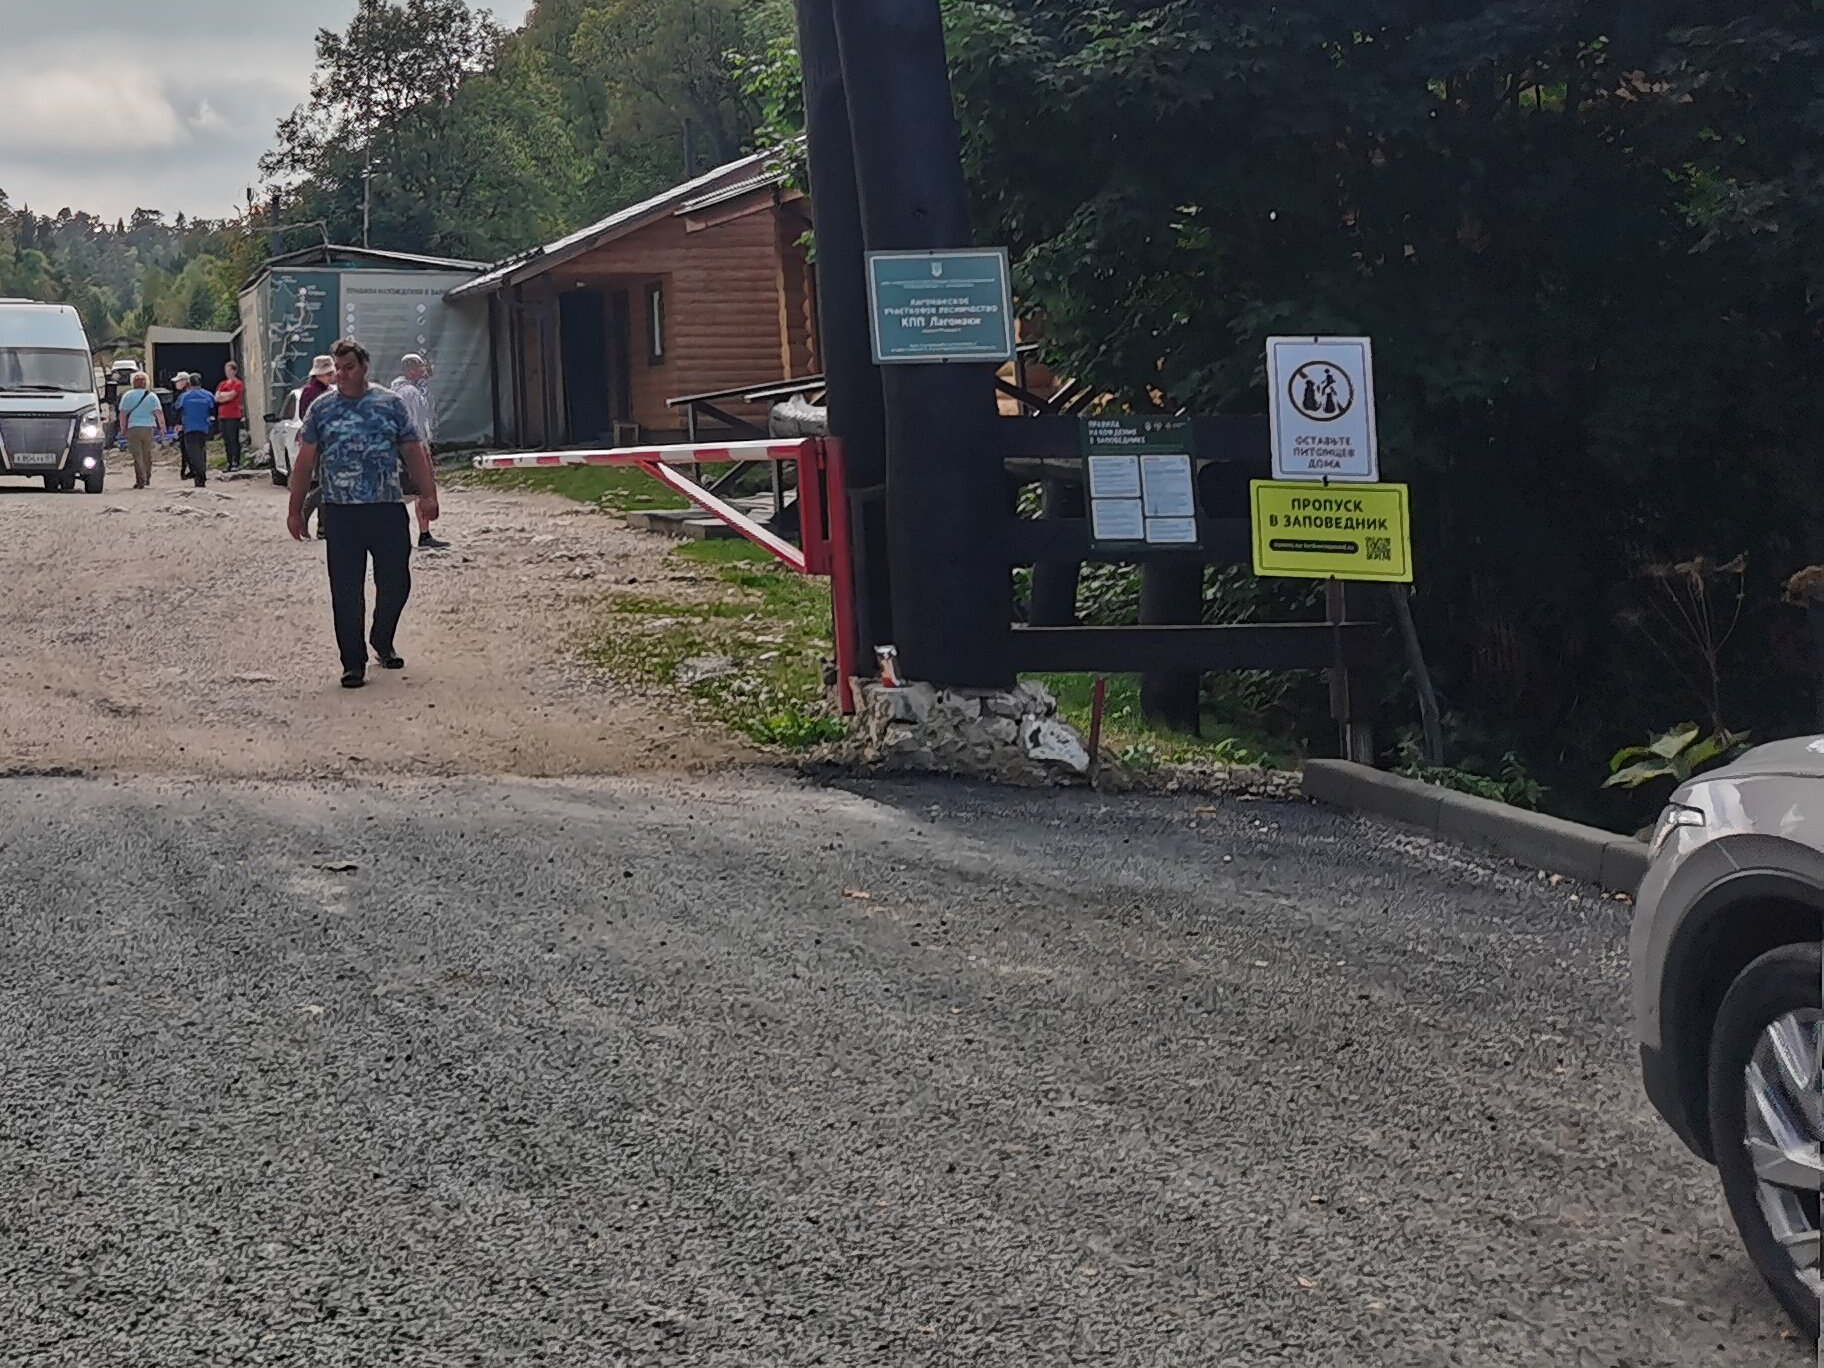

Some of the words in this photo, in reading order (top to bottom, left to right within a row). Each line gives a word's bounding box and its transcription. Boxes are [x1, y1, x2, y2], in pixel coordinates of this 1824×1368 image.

[1294, 435, 1352, 446] ОСТАВЬТЕ
[1293, 447, 1356, 458] ПИТОМЦЕВ
[1307, 458, 1341, 469] ДОМА
[1291, 498, 1364, 512] ПРОПУСК
[1269, 514, 1279, 527] В
[1283, 514, 1388, 531] ЗАПОВЕДНИК
